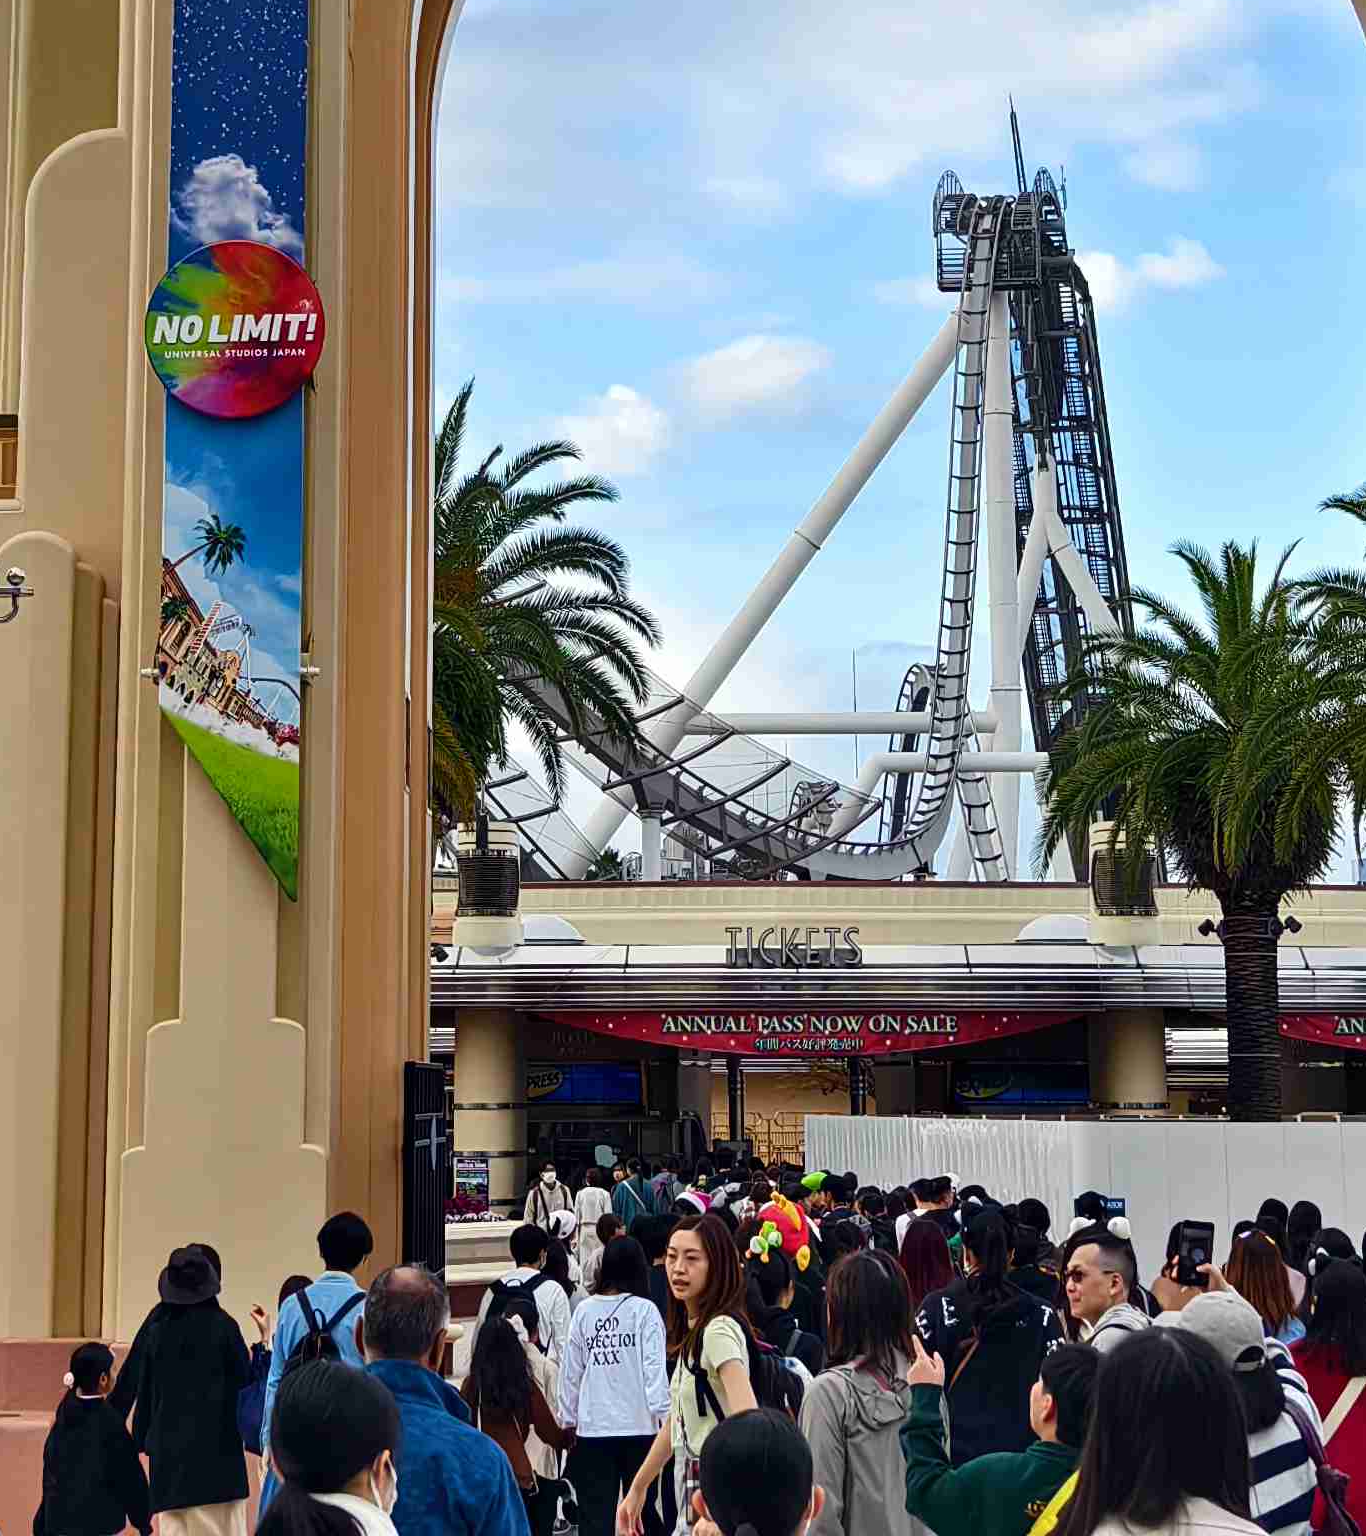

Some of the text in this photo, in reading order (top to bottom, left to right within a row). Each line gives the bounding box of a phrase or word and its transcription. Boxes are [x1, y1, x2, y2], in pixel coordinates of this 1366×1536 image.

[152, 313, 318, 344] NO LIMIT!
[164, 348, 306, 359] UNIVERSAL STUDIOS JAPAN
[725, 927, 862, 968] TICKETS
[662, 1015, 958, 1033] ANNUAL PASS NOW ON SALE
